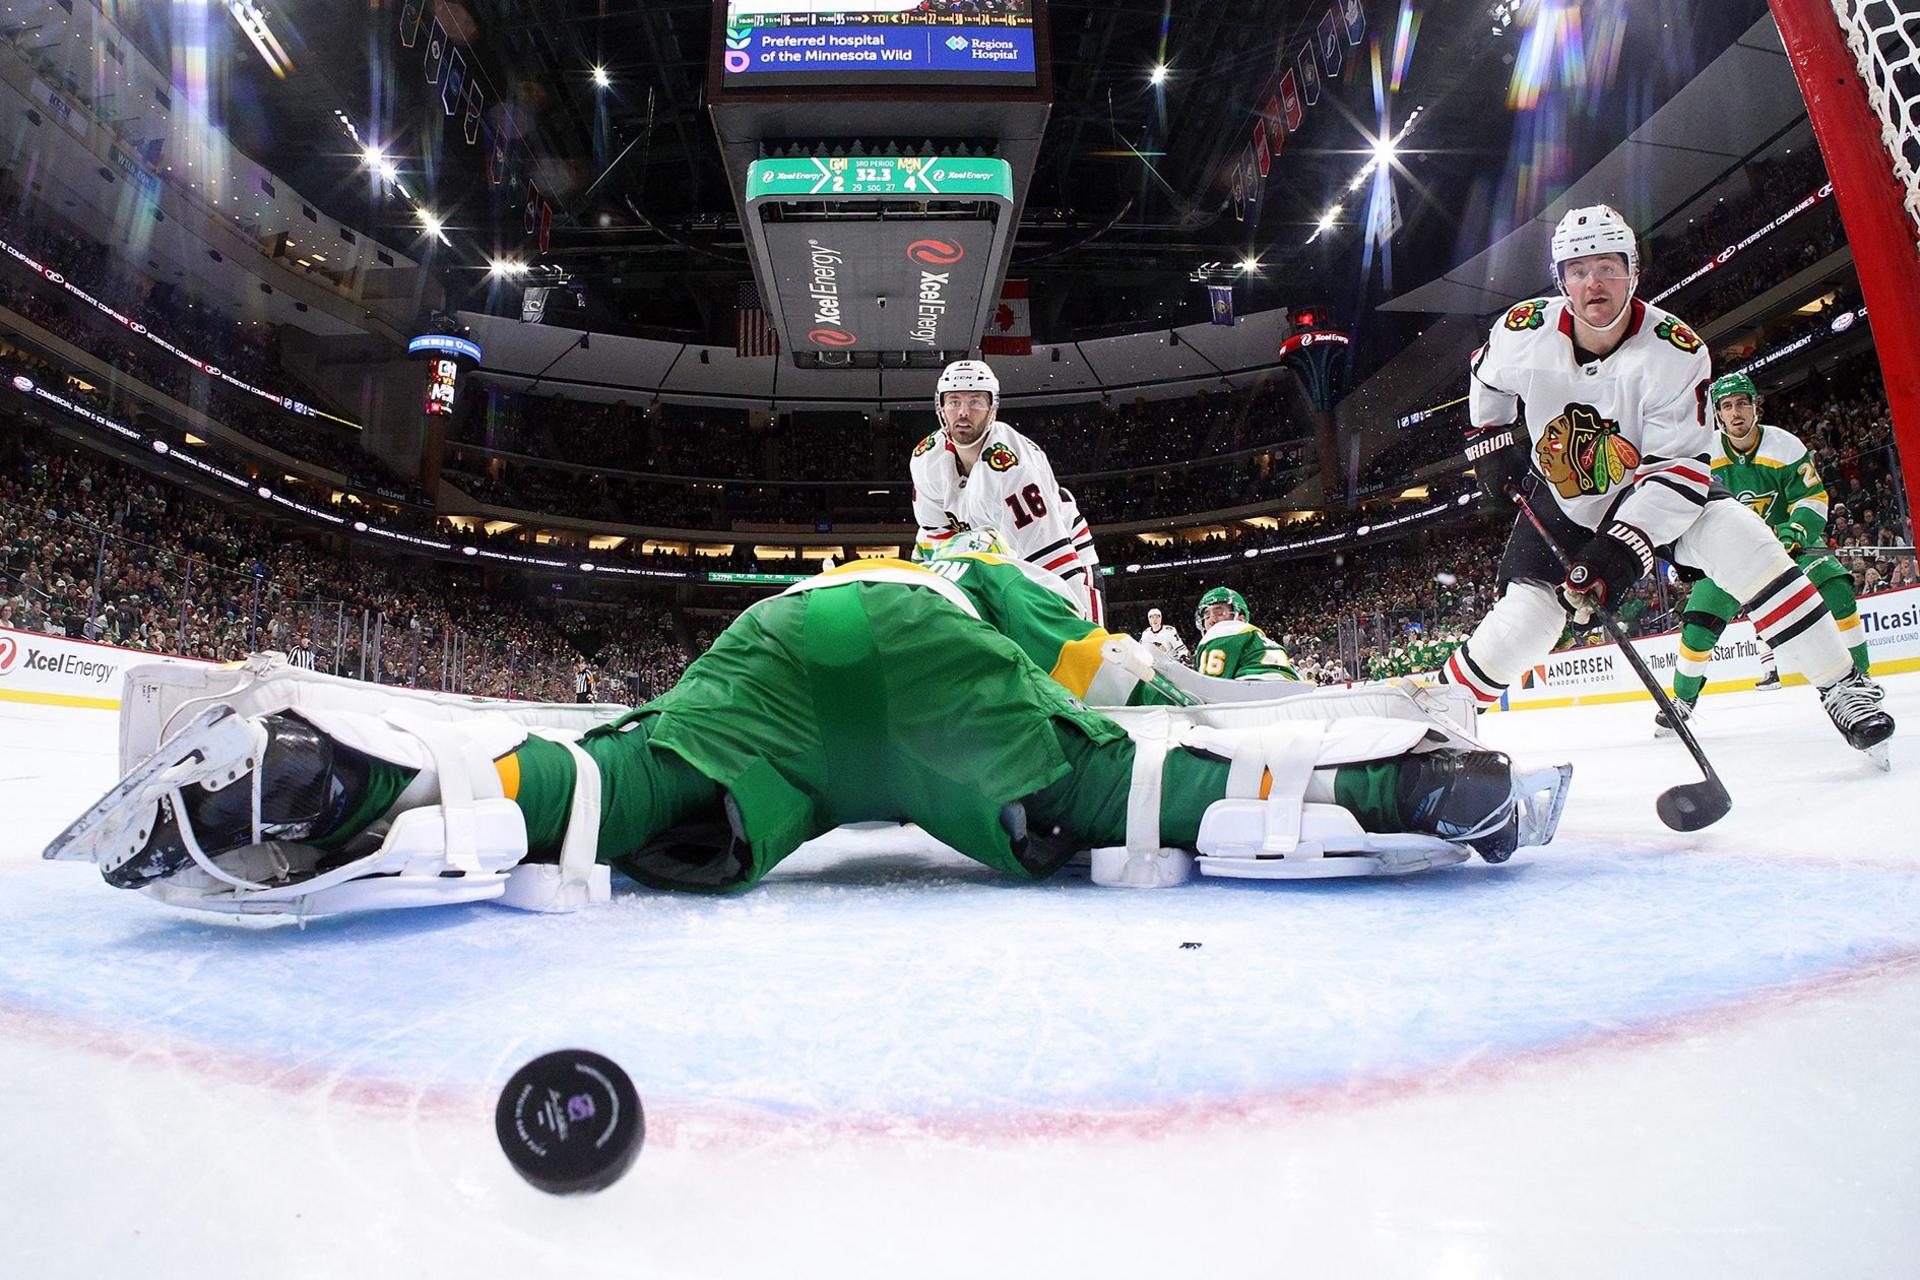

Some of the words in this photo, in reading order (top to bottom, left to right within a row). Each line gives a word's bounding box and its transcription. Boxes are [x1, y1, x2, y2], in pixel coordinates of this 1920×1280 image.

[762, 35, 826, 47] Preferred
[829, 34, 885, 47] hospital
[971, 39, 1013, 50] Regions
[761, 51, 776, 62] of
[778, 51, 801, 61] the
[805, 50, 877, 61] Minnesota
[881, 50, 912, 61] Wild
[971, 49, 1018, 61] Hospital
[856, 168, 892, 182] 32.3
[833, 176, 845, 192] 2
[903, 176, 917, 192] 4
[1578, 216, 1588, 225] 8
[1737, 223, 1775, 250] INTERSTATE
[1775, 196, 1815, 226] COMPANIES
[8, 246, 43, 272] COMPANIES
[1766, 334, 1812, 361] MANAGEMENT
[1005, 483, 1047, 530] 16
[1835, 549, 1880, 557] CCM
[1548, 656, 1613, 678] ANDERSEN
[1650, 654, 1665, 669] The
